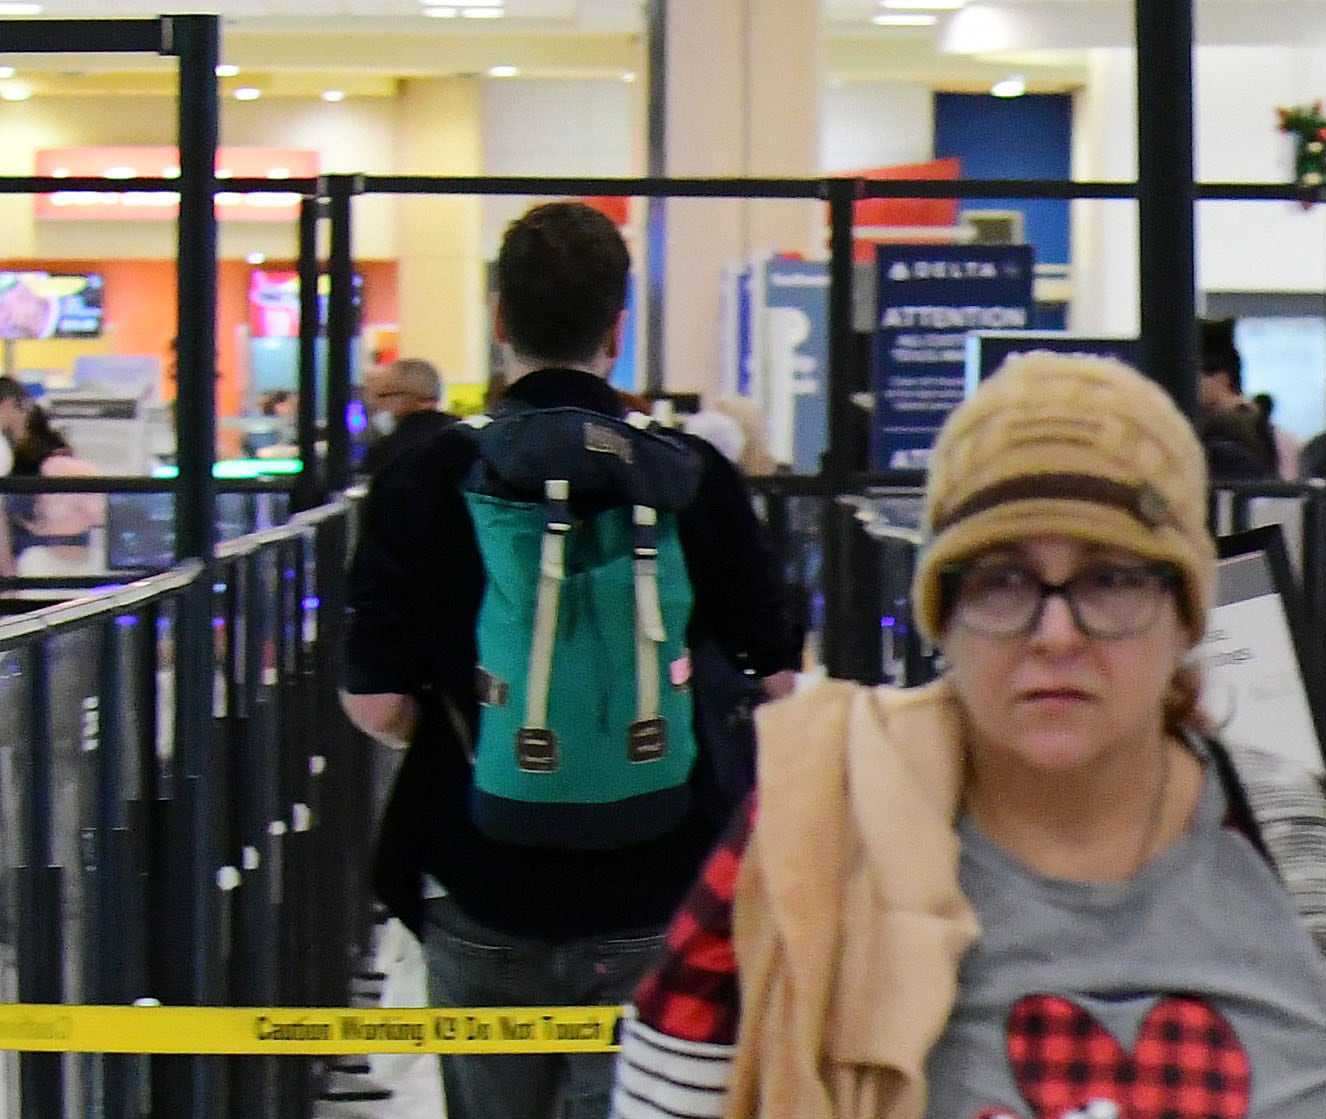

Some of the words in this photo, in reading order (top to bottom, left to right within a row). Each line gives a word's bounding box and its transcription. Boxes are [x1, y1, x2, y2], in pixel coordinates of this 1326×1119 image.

[882, 305, 1027, 327] ATTENTION
[253, 1015, 331, 1041] Caution
[341, 1015, 425, 1047] Working
[499, 1015, 535, 1041] Not
[542, 1014, 602, 1041] Touch
